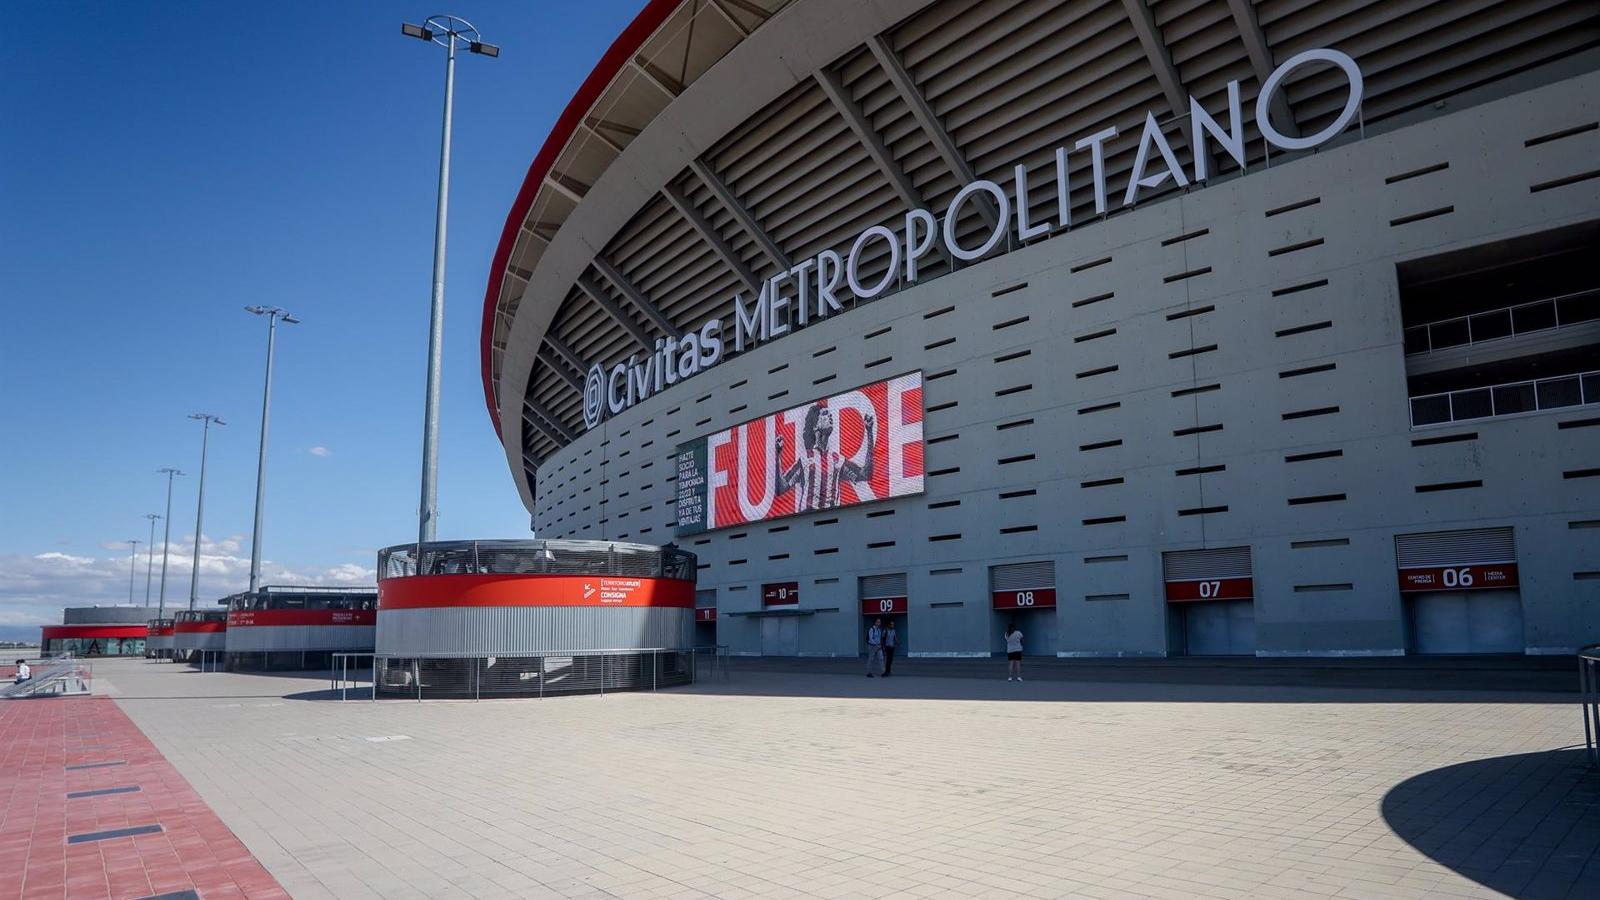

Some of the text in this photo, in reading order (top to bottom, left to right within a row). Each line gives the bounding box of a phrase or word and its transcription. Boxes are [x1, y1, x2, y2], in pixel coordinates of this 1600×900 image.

[608, 48, 1363, 413] Cívitas METROPOLITANO
[679, 460, 695, 471] SOCIO
[1443, 568, 1473, 587] 06
[779, 588, 787, 599] 10
[1200, 581, 1221, 597] 07
[1017, 592, 1034, 606] 08
[880, 600, 893, 612] 09
[704, 610, 710, 620] 11
